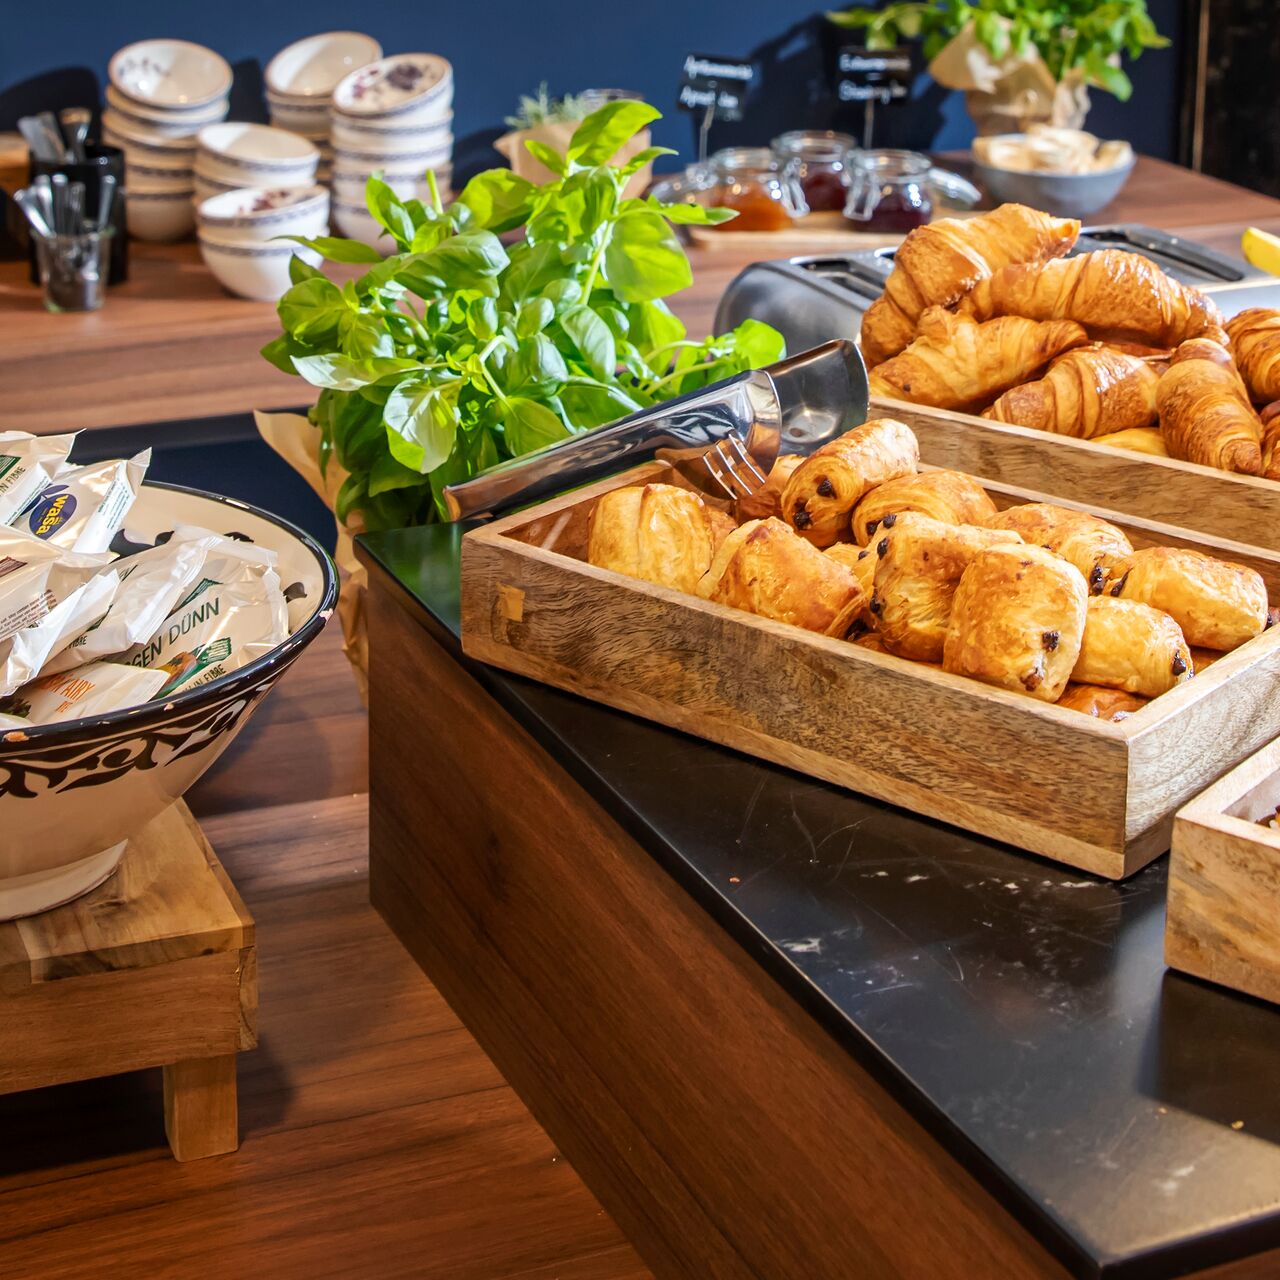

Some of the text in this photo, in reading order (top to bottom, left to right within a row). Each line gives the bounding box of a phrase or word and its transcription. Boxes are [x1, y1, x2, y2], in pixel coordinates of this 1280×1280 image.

[0, 480, 9, 494] IN
[6, 466, 26, 488] FIBRE
[35, 493, 69, 536] wasa
[168, 597, 220, 645] DÜNN
[59, 677, 97, 702] AIRY
